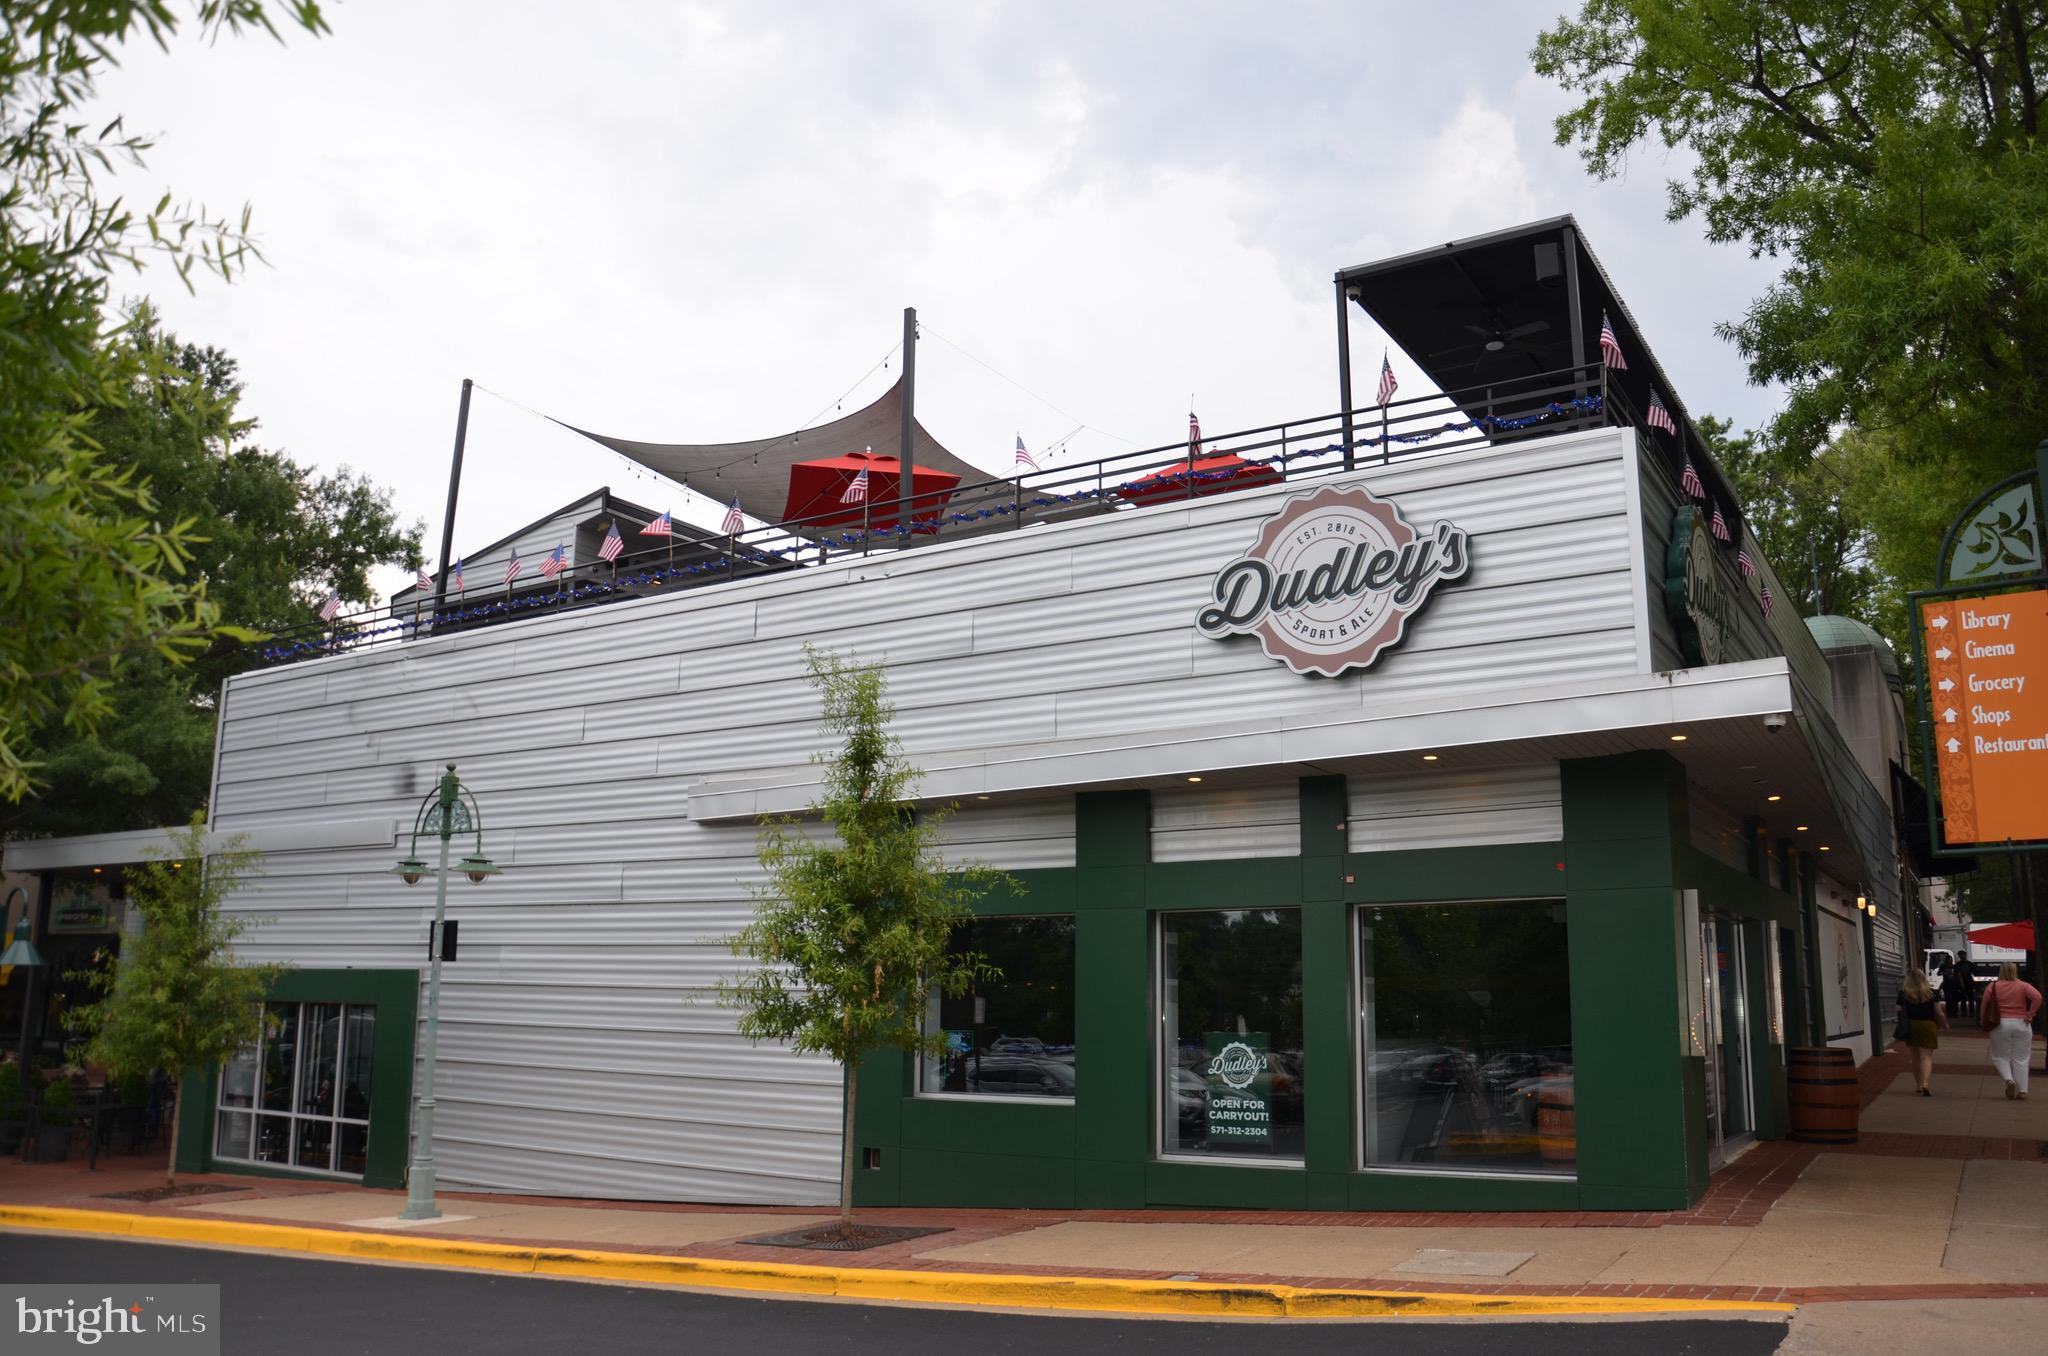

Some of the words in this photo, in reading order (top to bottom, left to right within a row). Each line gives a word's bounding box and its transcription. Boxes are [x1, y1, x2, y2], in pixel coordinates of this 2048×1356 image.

[1199, 524, 1462, 631] Dudley's
[1339, 624, 1348, 637] &
[1350, 607, 1374, 631] ALE
[1961, 611, 2010, 629] Library
[1965, 640, 2015, 659] Cinema
[1968, 673, 2025, 693] Grocery
[1971, 705, 2011, 726] Shops
[1207, 1055, 1268, 1075] Dudley's
[1212, 1099, 1241, 1109] OPEN
[1243, 1100, 1265, 1109] FOR
[1208, 1110, 1270, 1121] CARRYOUT!
[1210, 1126, 1268, 1136] 571-312-2304
